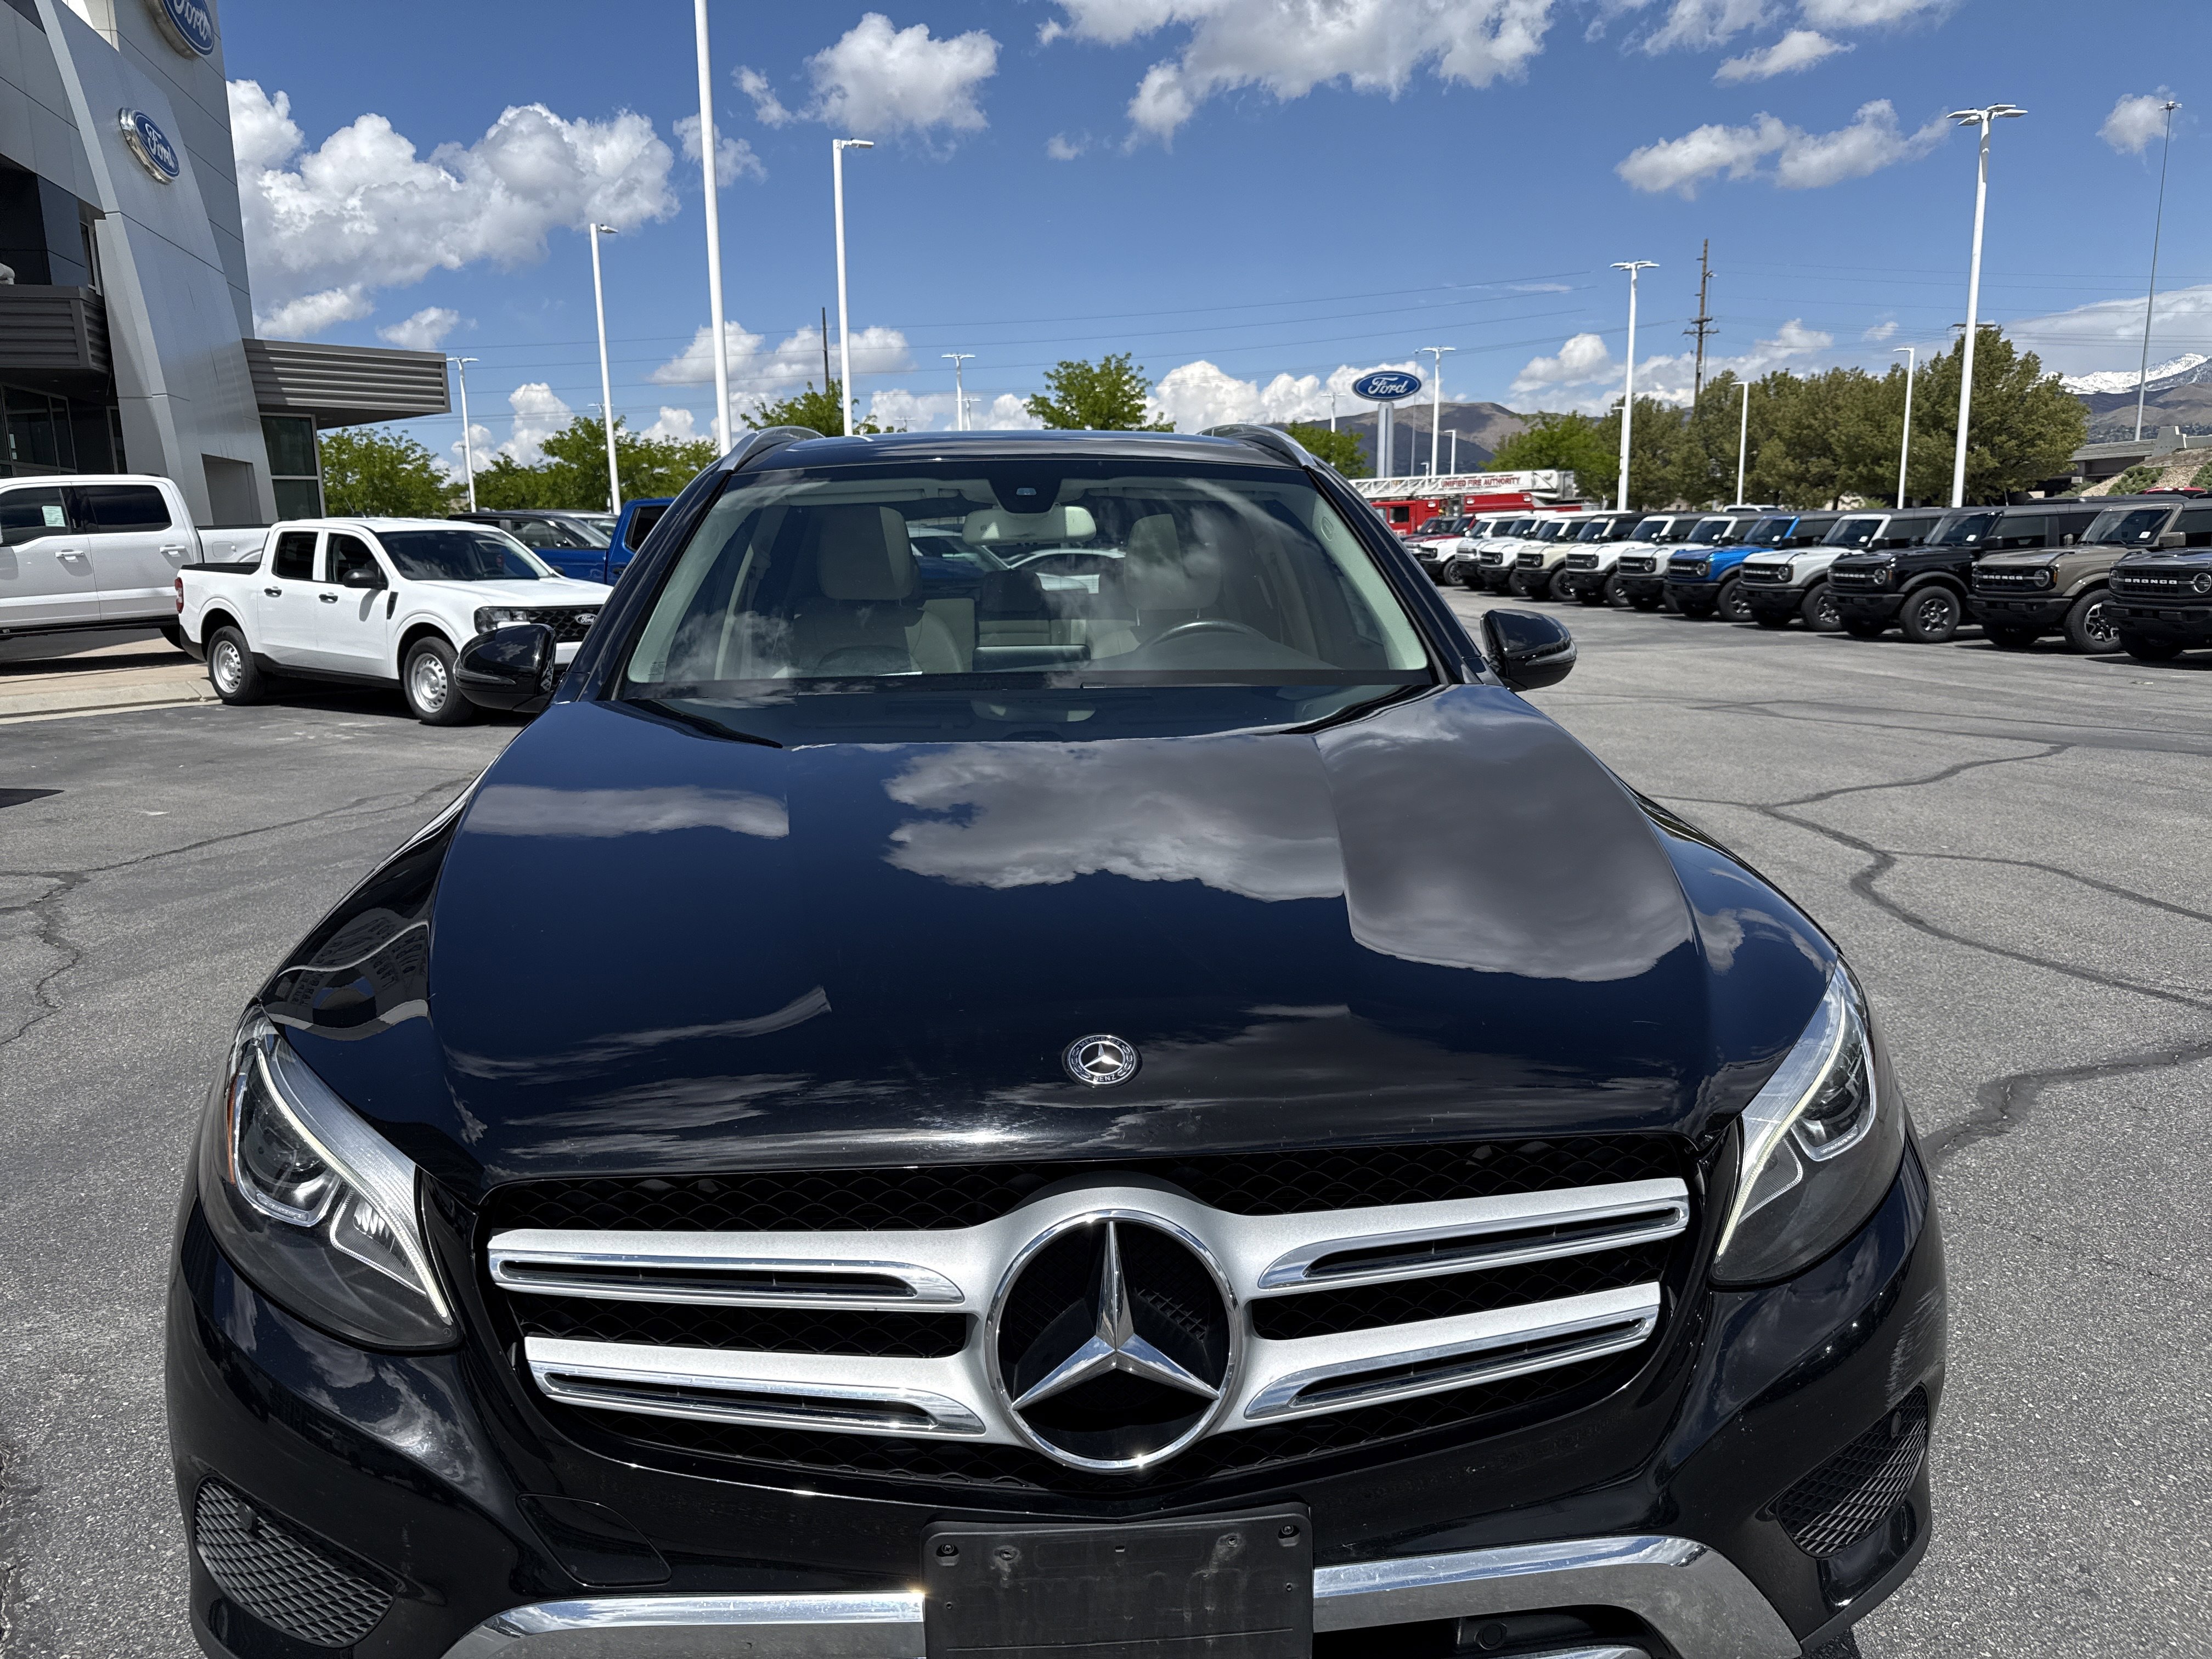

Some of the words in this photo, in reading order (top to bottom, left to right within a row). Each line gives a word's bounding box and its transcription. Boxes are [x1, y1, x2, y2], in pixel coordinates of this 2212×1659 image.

[145, 123, 174, 169] Ford
[1368, 377, 1409, 394] Ford
[1483, 477, 1520, 486] AUTHORITY
[1093, 1074, 1117, 1082] BENZ
